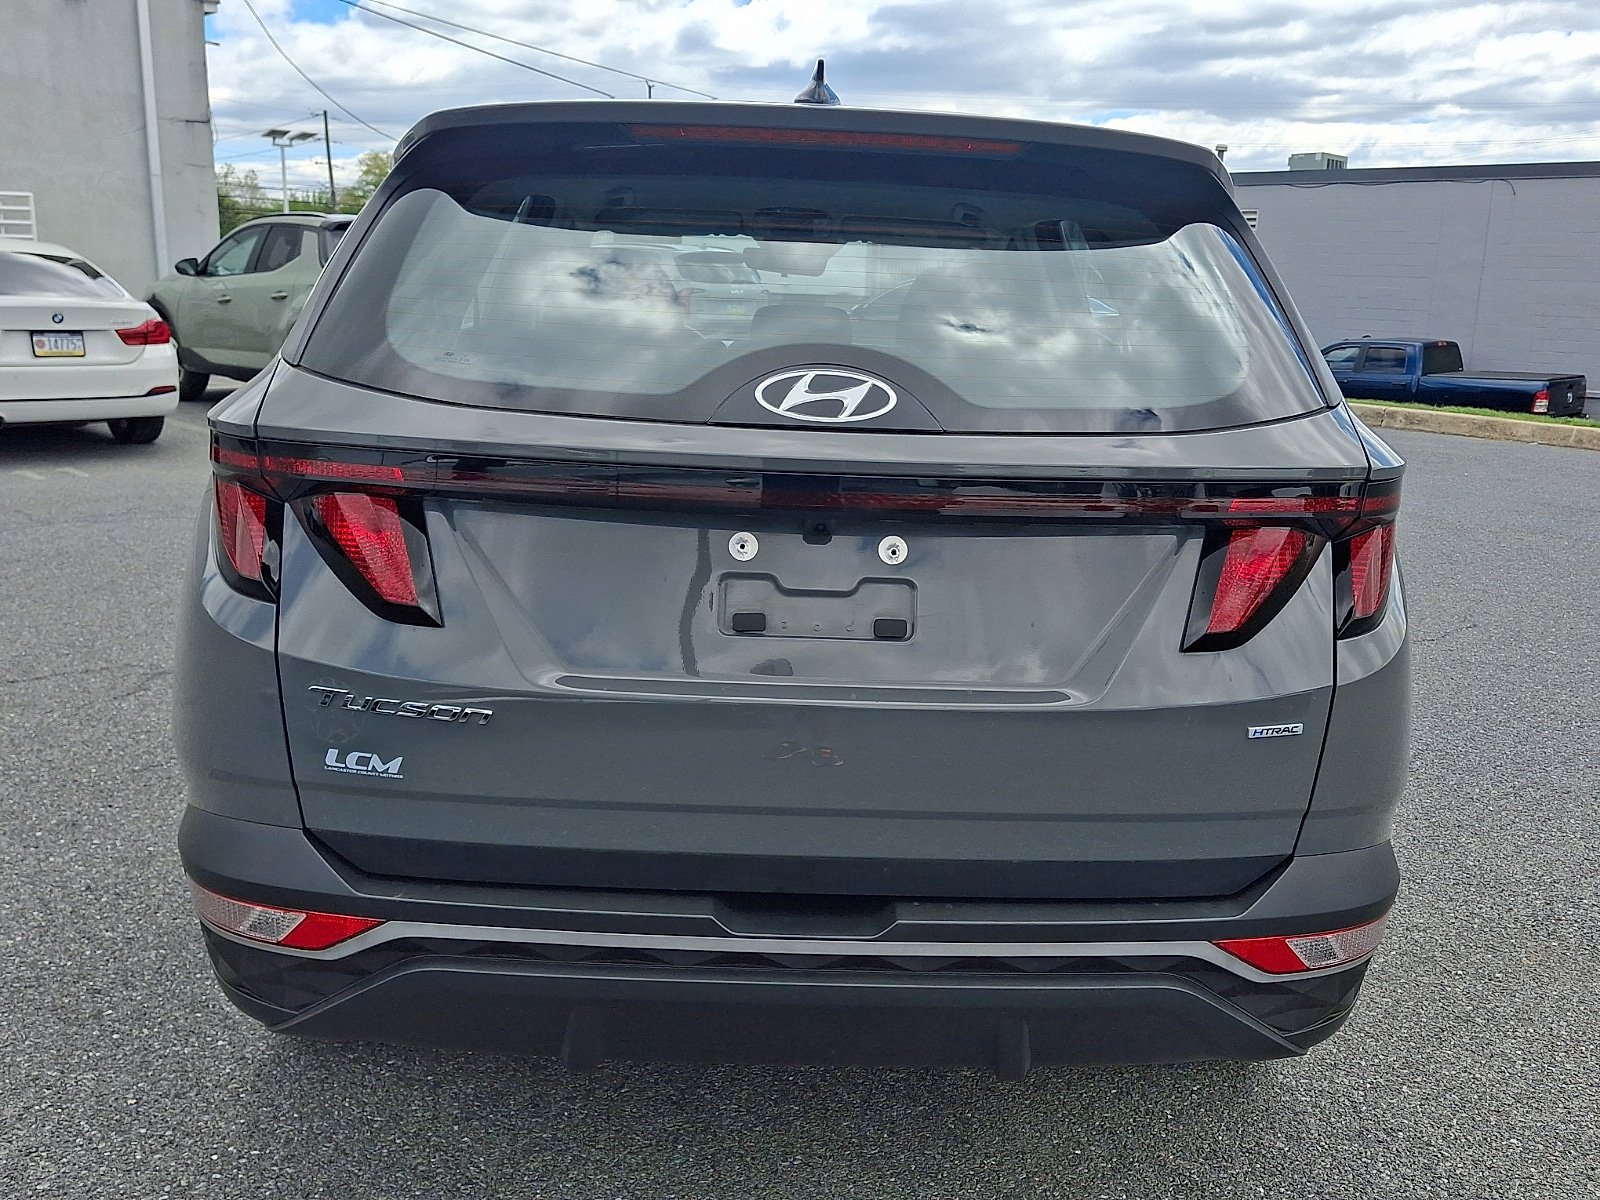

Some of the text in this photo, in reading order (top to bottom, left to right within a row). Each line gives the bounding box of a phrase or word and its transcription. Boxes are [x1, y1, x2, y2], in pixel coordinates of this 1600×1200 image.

[1252, 725, 1300, 736] HTRAC
[325, 748, 403, 774] LCM
[324, 765, 357, 774] LANCASTER
